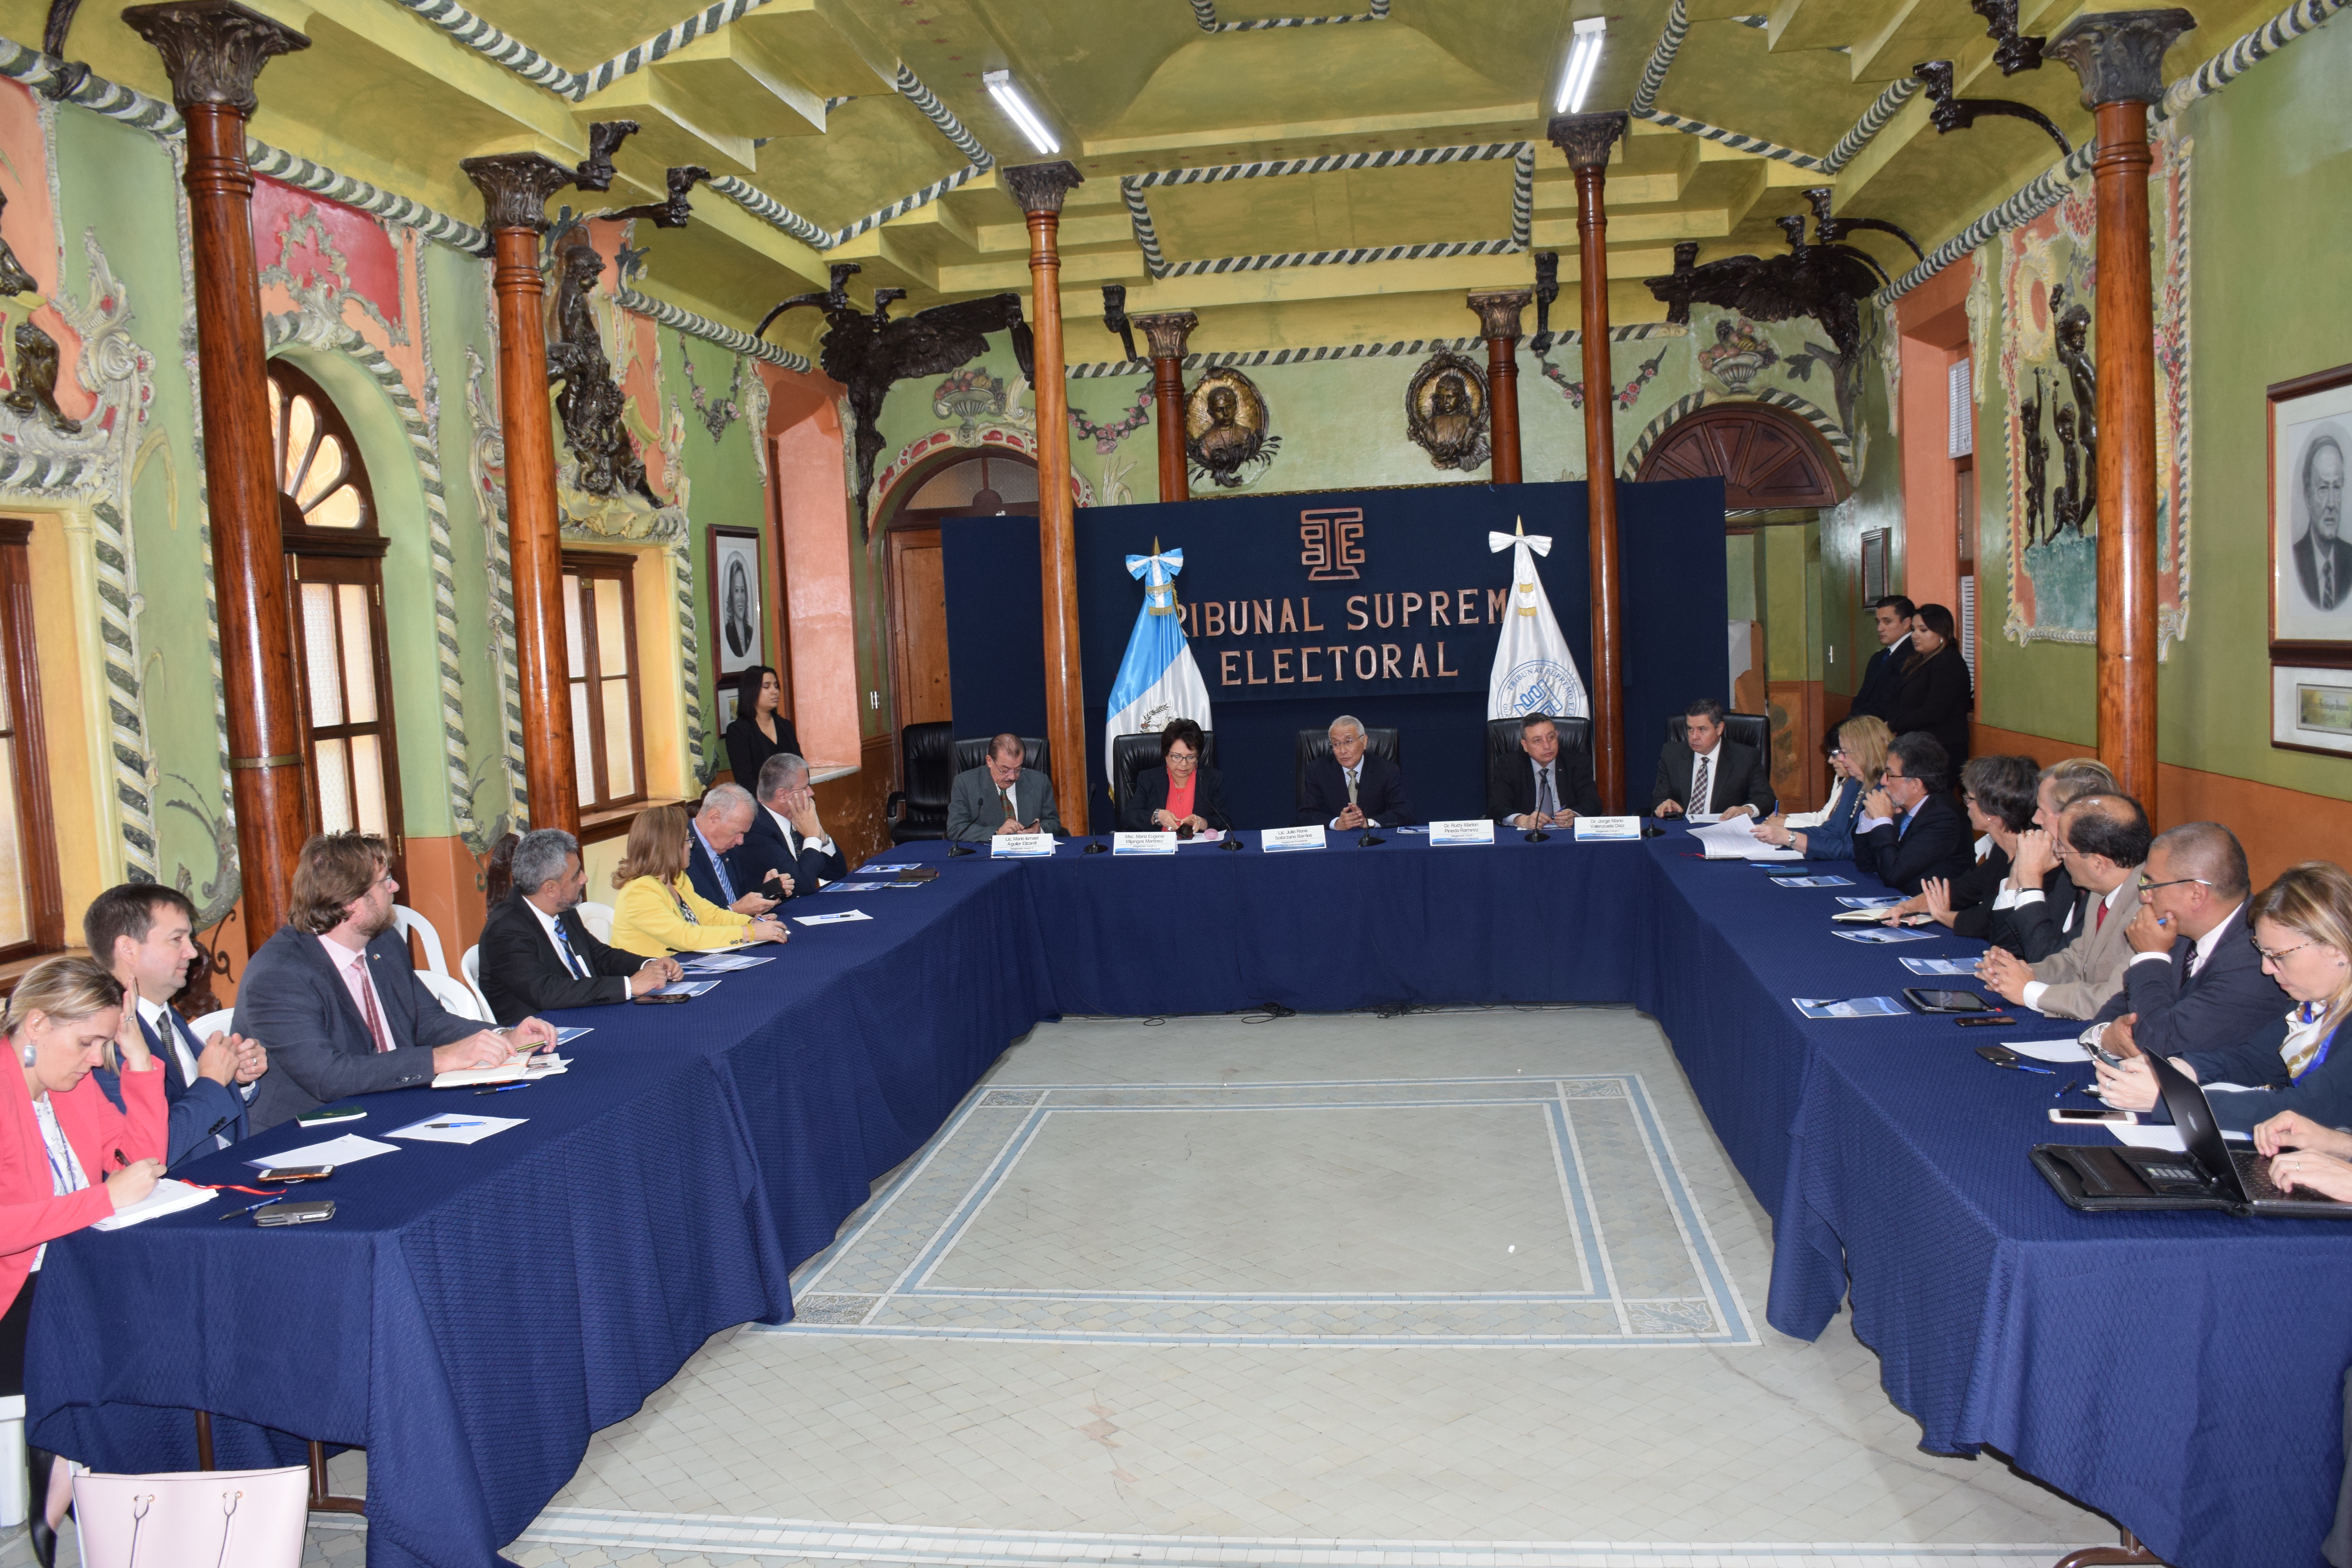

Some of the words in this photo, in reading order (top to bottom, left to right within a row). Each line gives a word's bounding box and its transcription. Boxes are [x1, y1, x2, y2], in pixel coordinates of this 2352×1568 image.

[1178, 597, 1324, 637] RIBUNAL
[1347, 588, 1507, 630] SUPREM
[1220, 642, 1458, 685] ELECTORAL
[1508, 667, 1543, 691] TRIBUNAL
[1547, 668, 1573, 699] SUPREMO
